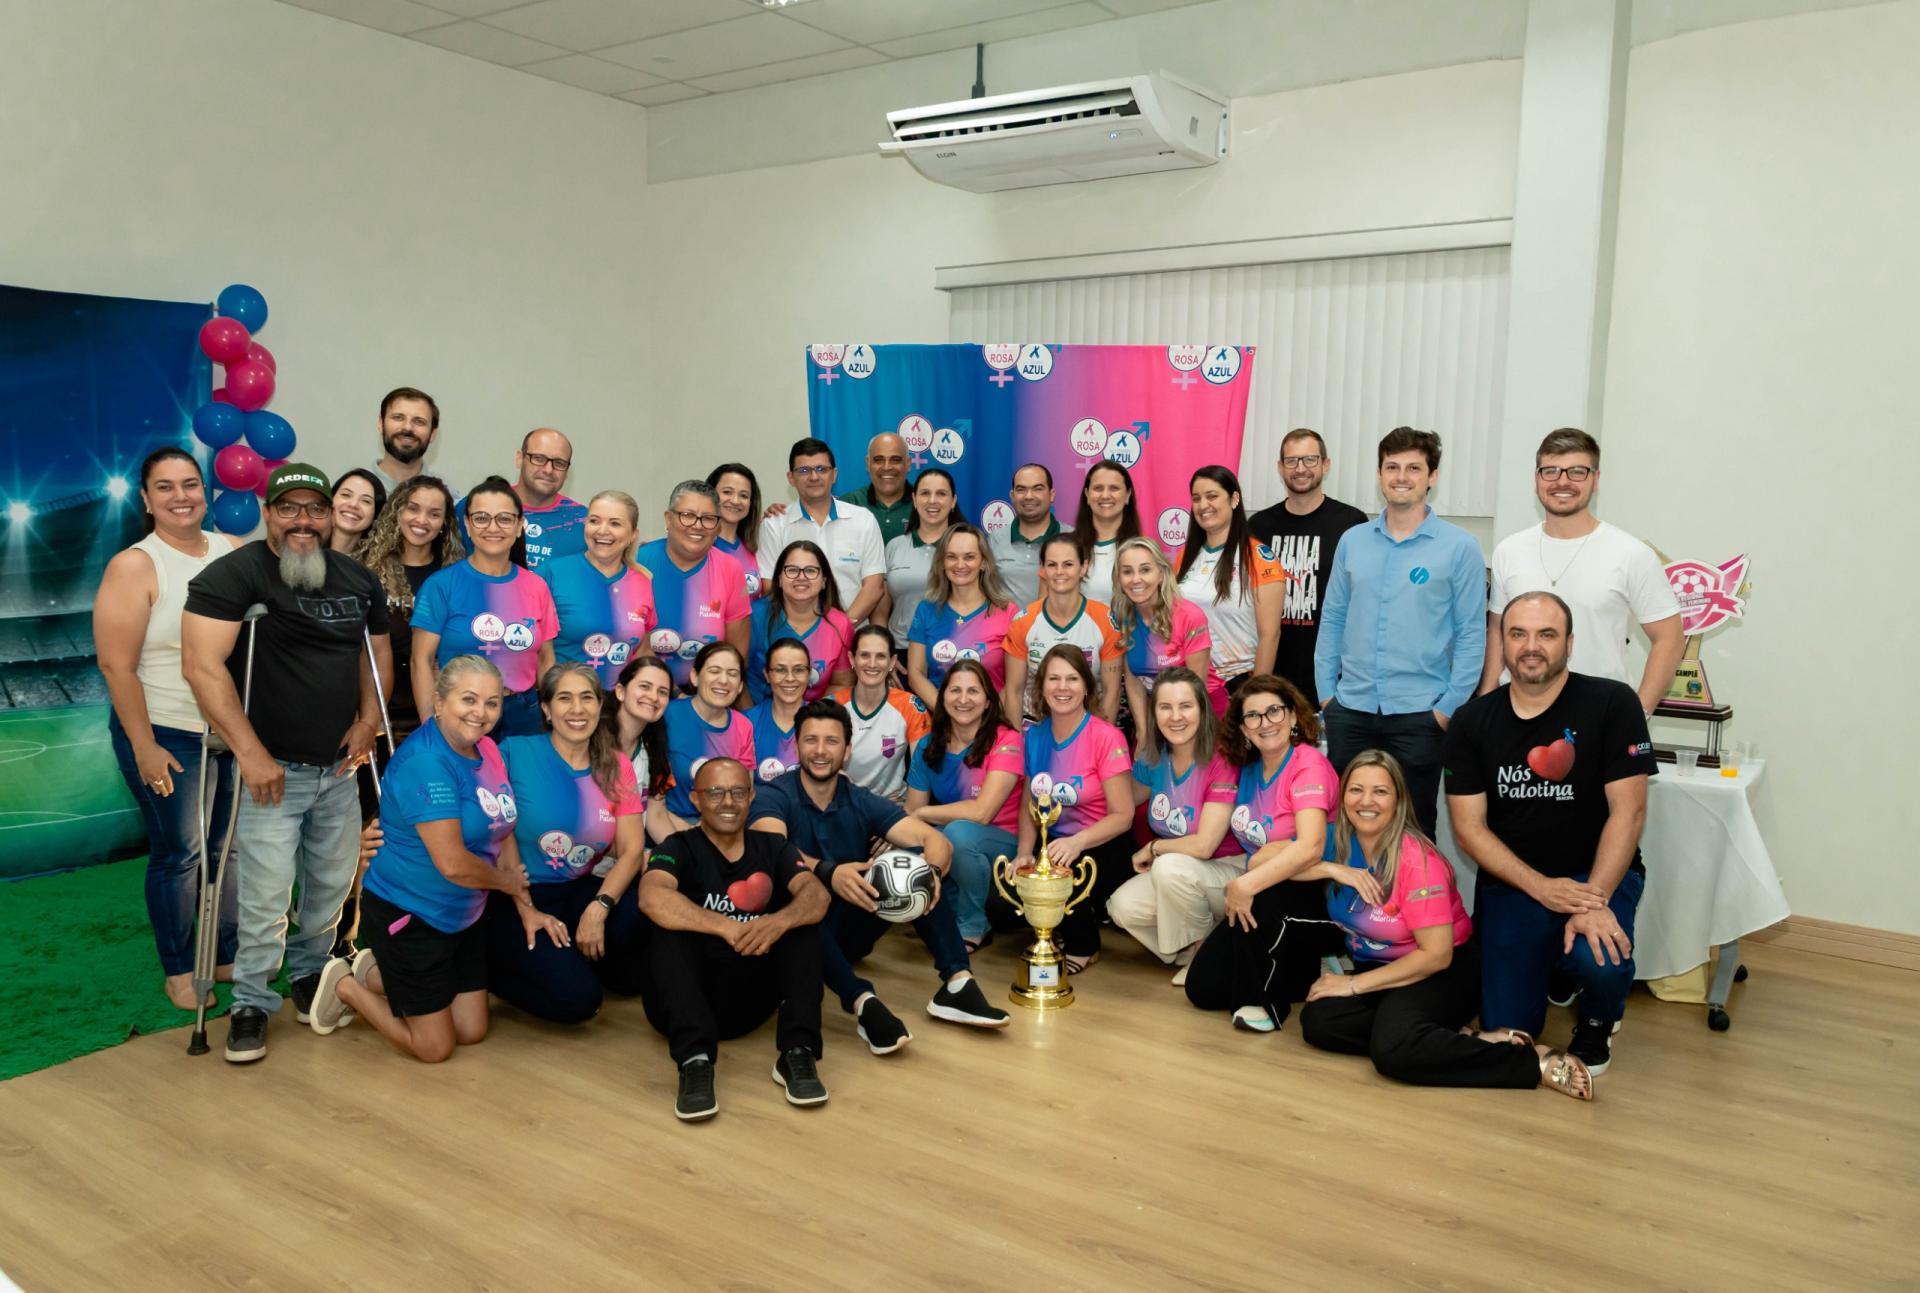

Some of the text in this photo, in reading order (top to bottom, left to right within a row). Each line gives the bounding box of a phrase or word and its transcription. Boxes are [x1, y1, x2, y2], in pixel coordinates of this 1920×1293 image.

[817, 352, 839, 361] ROSA
[990, 353, 1014, 363] ROSA
[1174, 355, 1199, 365] ROSA
[848, 363, 871, 373] AZUL
[1022, 364, 1046, 374] AZUL
[1207, 366, 1232, 376] AZUL
[905, 436, 927, 446] ROSA
[1076, 441, 1100, 451] ROSA
[936, 449, 958, 459] AZUL
[1110, 453, 1133, 463] AZUL
[1163, 530, 1186, 540] ROSA
[1497, 765, 1531, 783] Nós
[1497, 781, 1574, 798] Palotina
[703, 893, 735, 912] Nós
